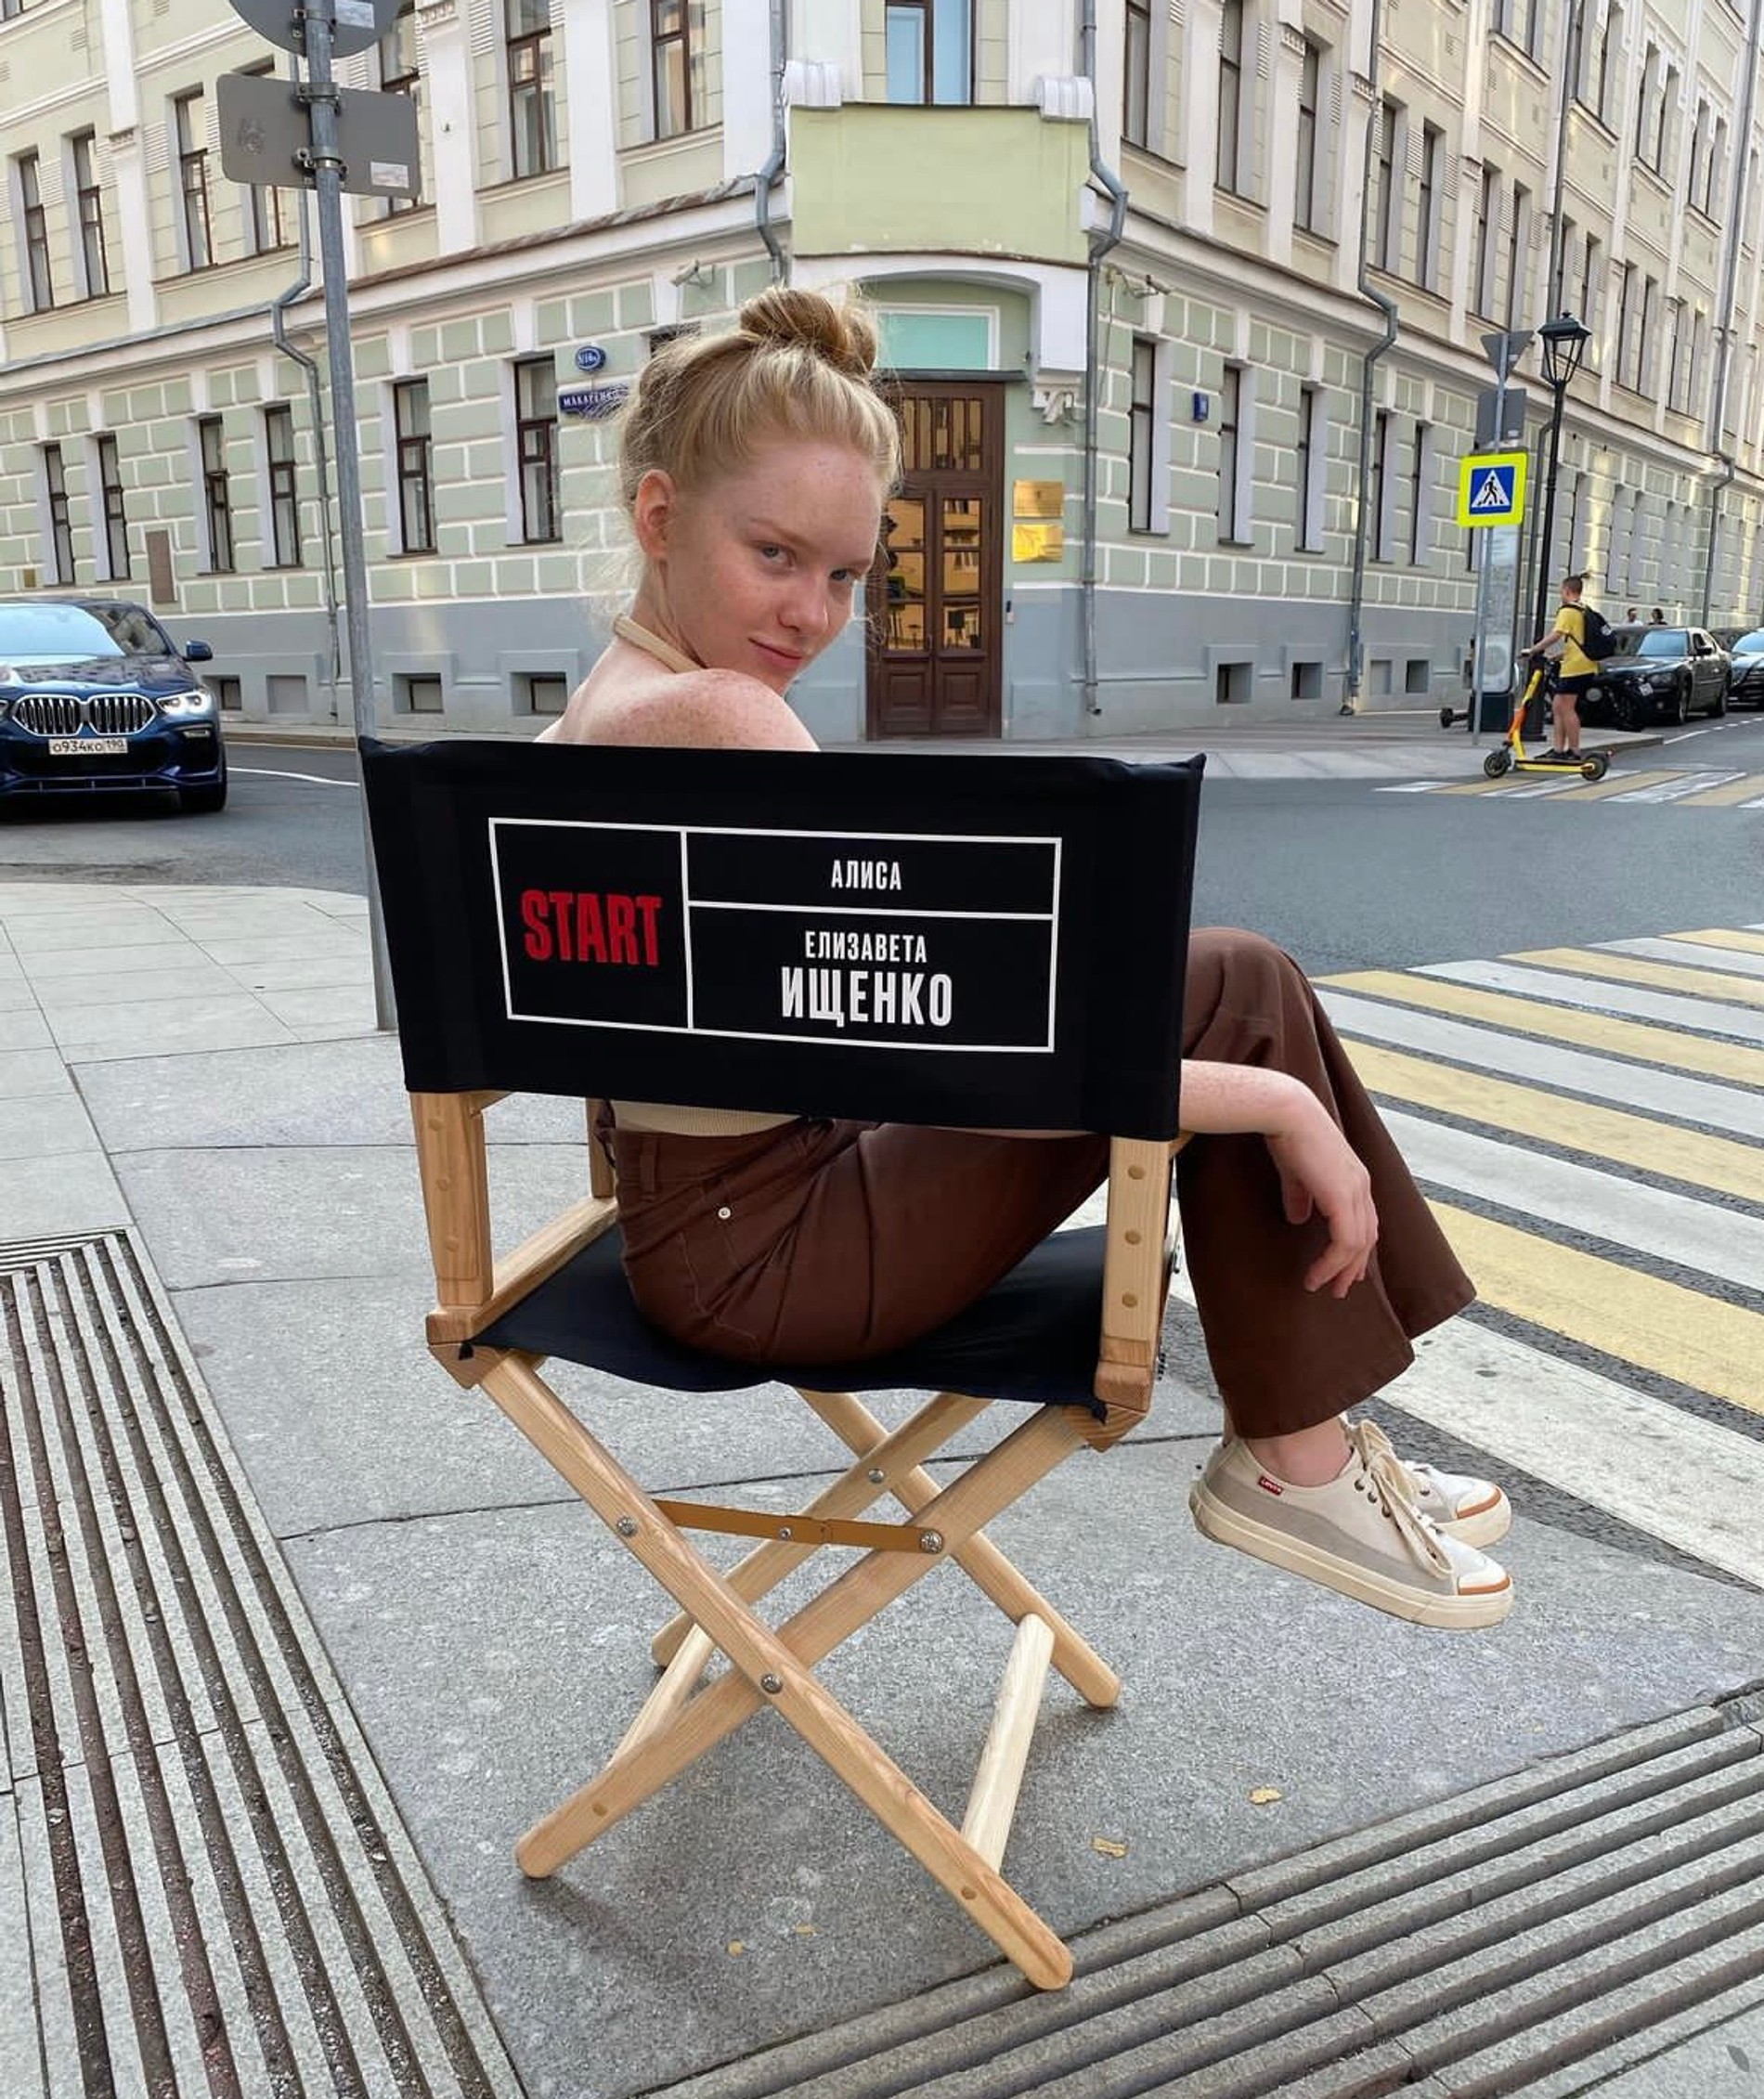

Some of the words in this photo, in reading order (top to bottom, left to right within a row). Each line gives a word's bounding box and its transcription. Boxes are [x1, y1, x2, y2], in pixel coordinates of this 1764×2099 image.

[831, 860, 901, 890] АЛИСА
[522, 890, 661, 965] START
[805, 930, 927, 964] ЕЛИЗАВЕТА
[781, 966, 953, 1028] ИЩЕНКО
